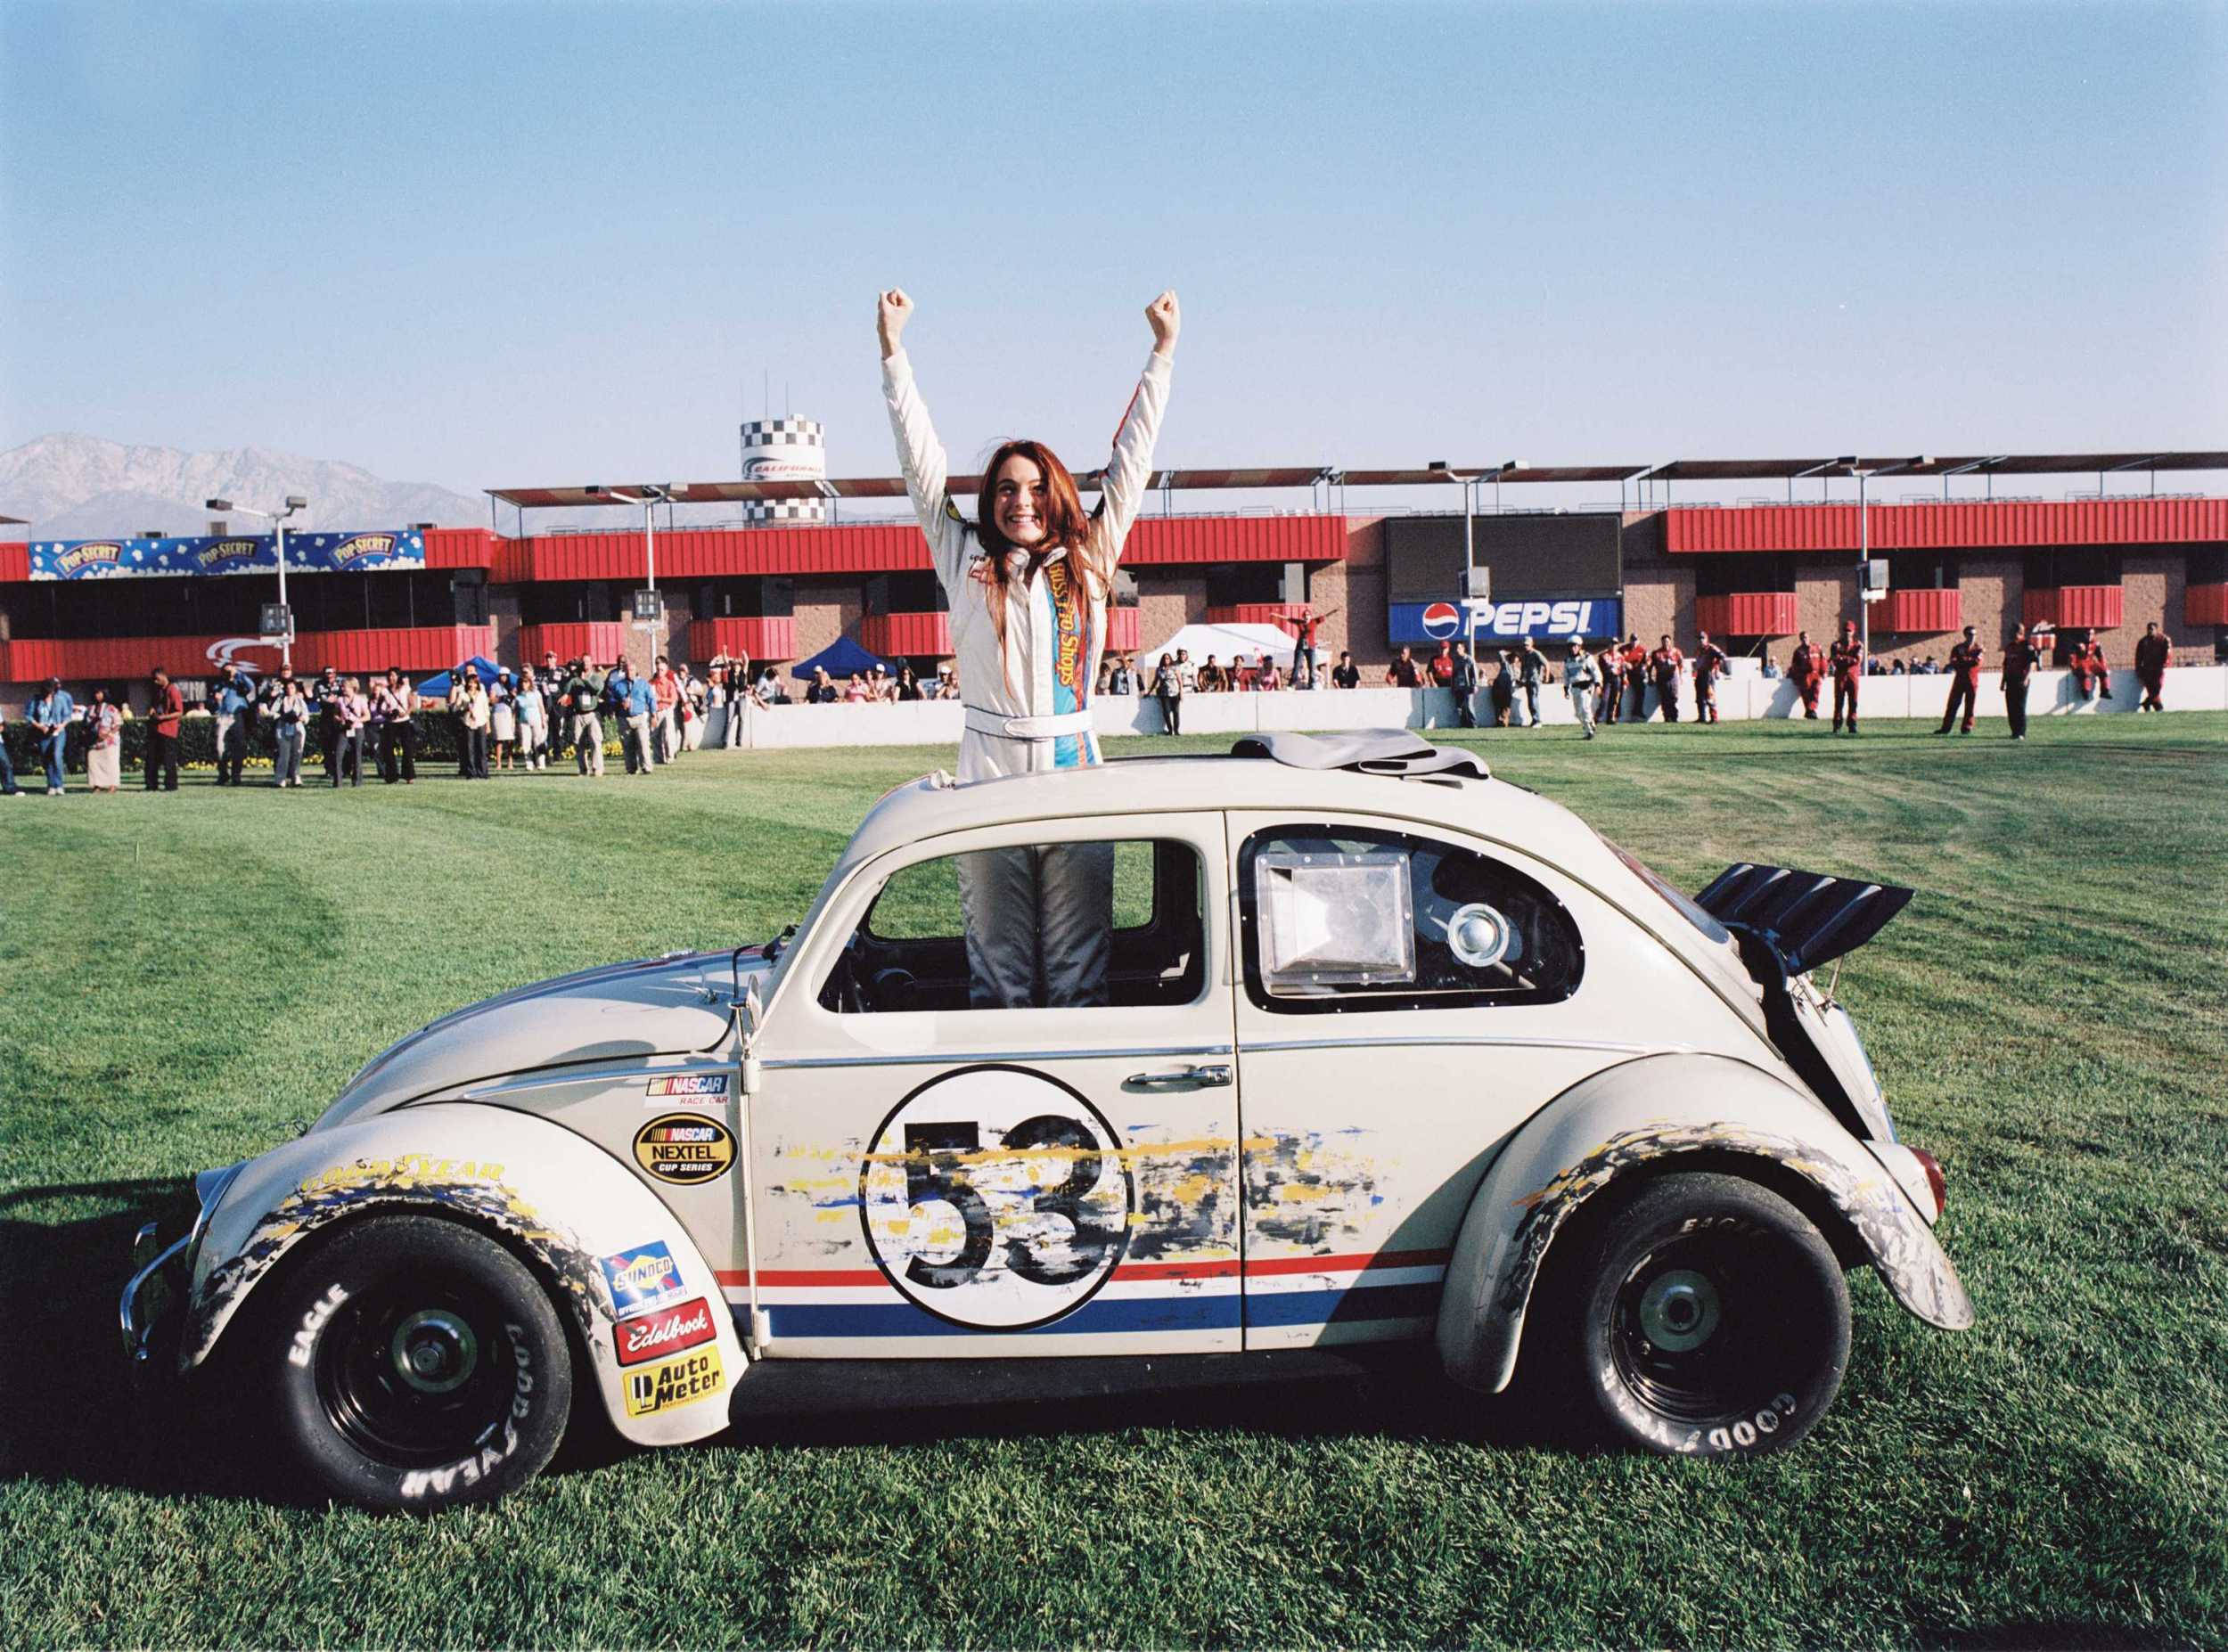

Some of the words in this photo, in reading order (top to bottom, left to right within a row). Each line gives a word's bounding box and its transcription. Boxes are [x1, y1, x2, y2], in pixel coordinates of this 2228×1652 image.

[1463, 601, 1593, 636] PEPSI
[1056, 634, 1079, 686] Shops
[670, 1075, 724, 1094] NASCAR
[679, 1097, 706, 1105] RACE
[709, 1096, 729, 1104] CAR
[671, 1127, 715, 1141] NASCAR
[651, 1145, 717, 1159] NEXTEL
[658, 1163, 678, 1172] CUP
[680, 1163, 714, 1172] SERIES
[903, 1115, 1103, 1288] 53
[617, 1258, 671, 1290] SUNOCO
[288, 1283, 348, 1368] EAGLE
[627, 1309, 709, 1353] Edelbrock
[659, 1356, 709, 1386] Auto
[655, 1370, 720, 1411] Meter
